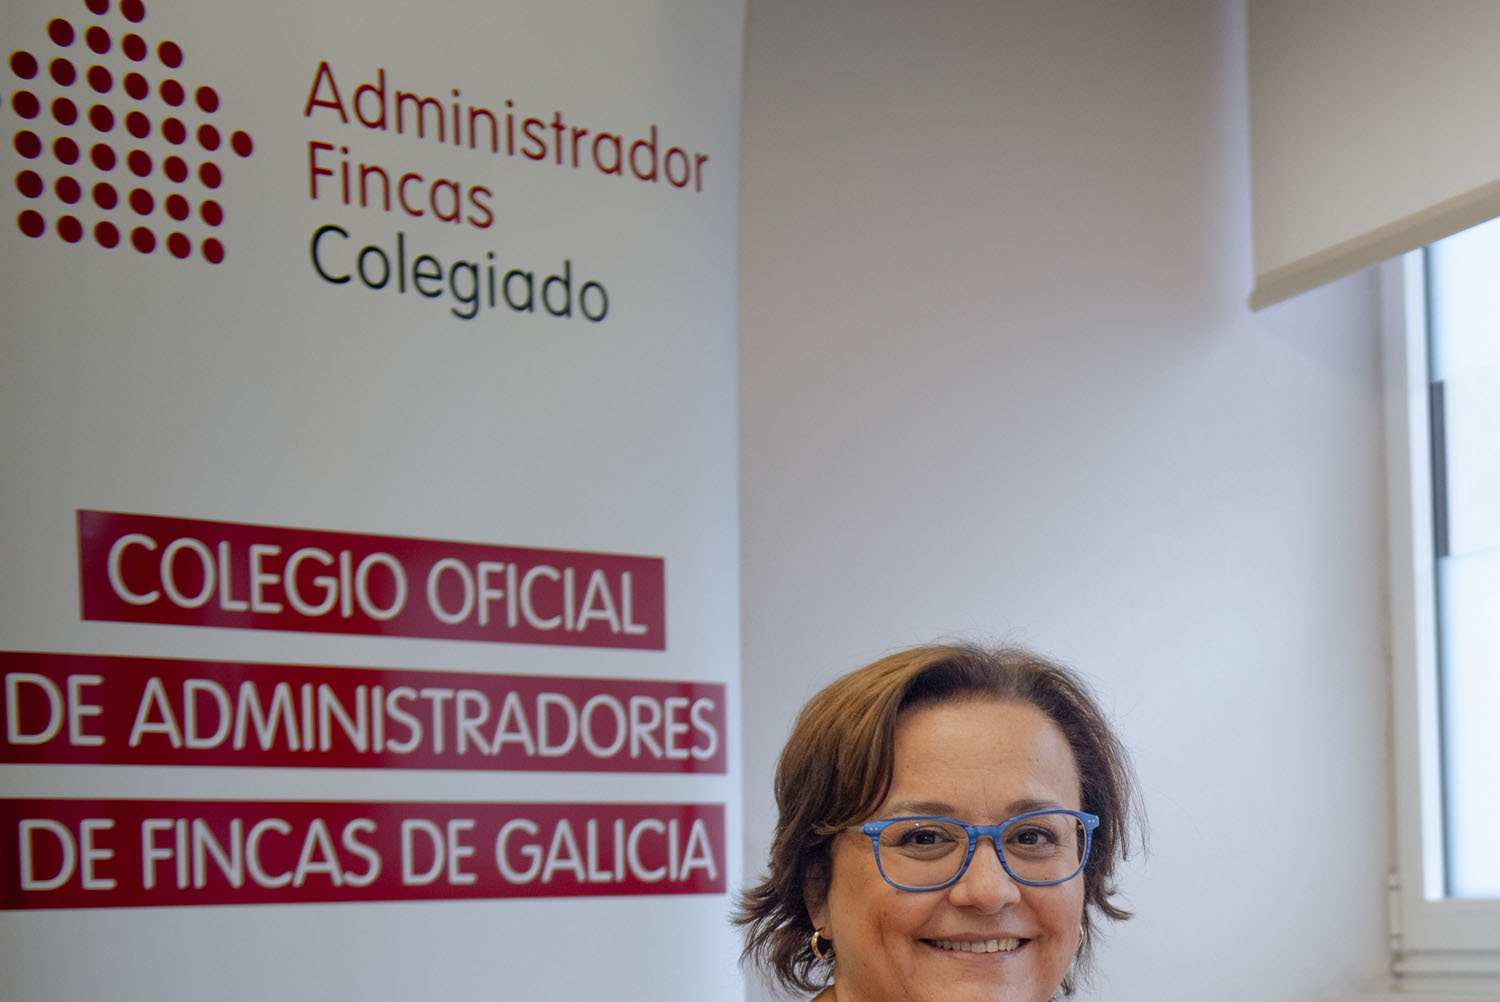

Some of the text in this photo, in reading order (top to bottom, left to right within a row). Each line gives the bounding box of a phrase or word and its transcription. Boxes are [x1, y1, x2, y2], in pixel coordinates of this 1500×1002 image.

[303, 60, 710, 193] Administrador
[307, 140, 495, 230] Fincas
[309, 225, 610, 323] Colegiado
[107, 533, 648, 635] COLEGIO OFICIAL
[4, 671, 720, 760] DE ADMINISTRADORES
[18, 818, 720, 891] DE FINCAS DE GALICIA
